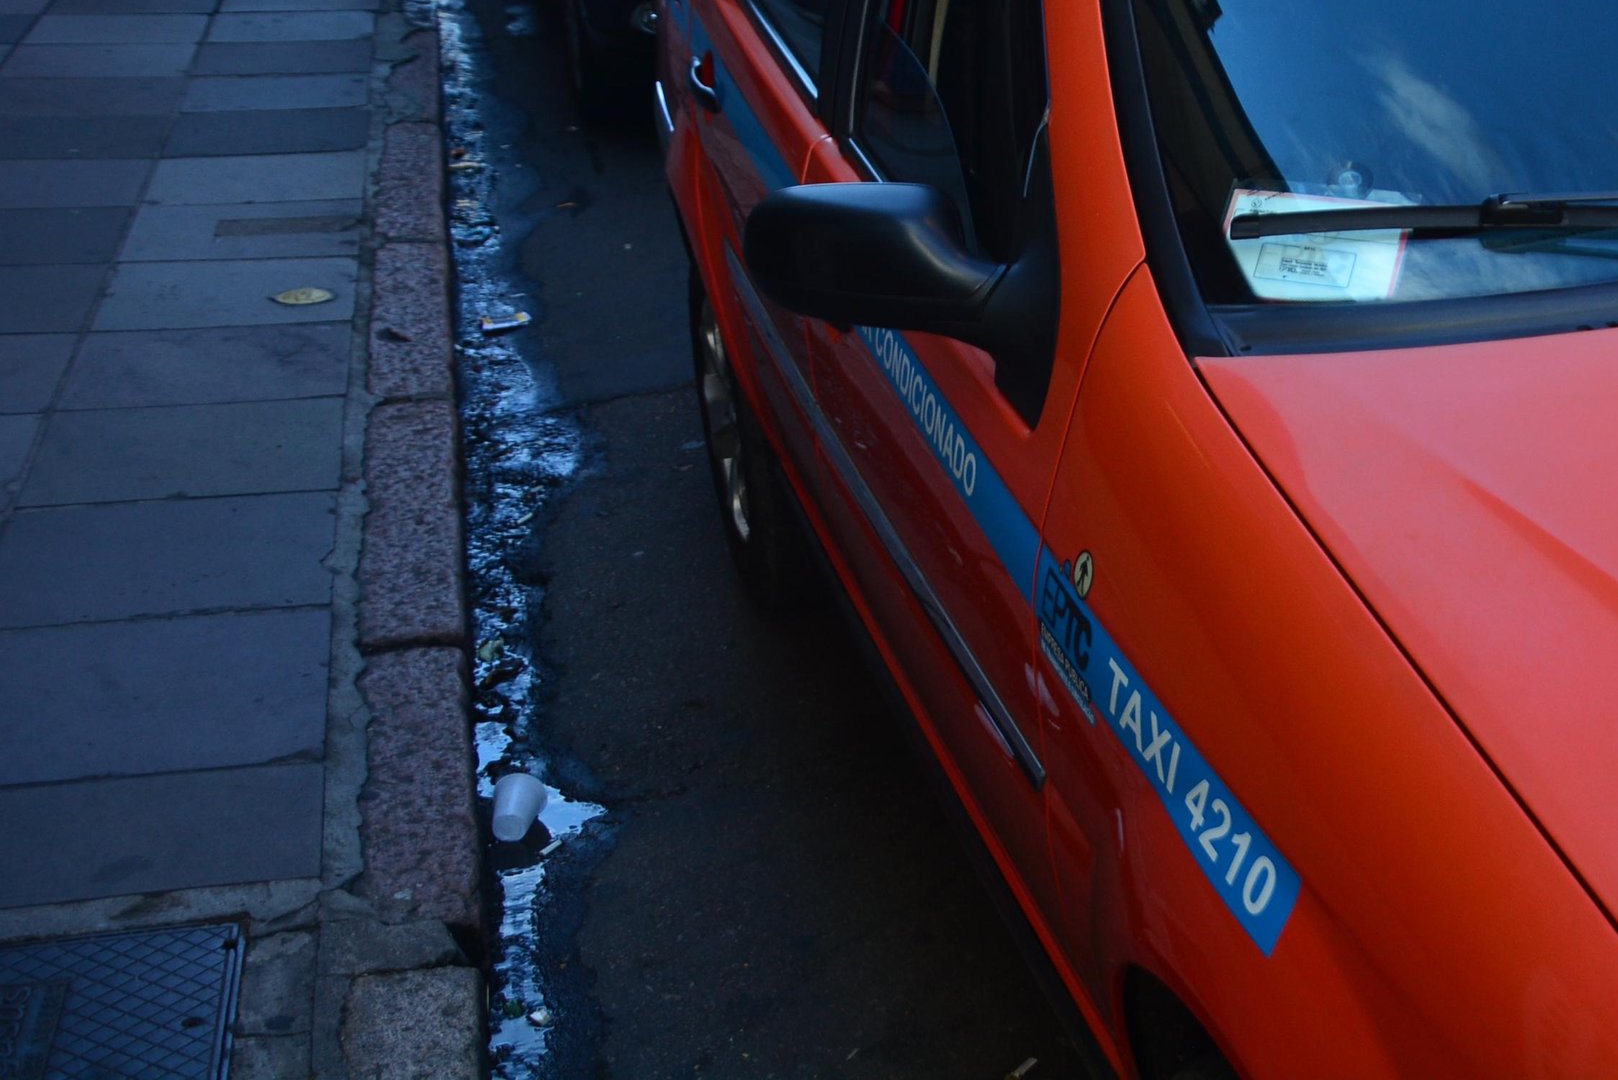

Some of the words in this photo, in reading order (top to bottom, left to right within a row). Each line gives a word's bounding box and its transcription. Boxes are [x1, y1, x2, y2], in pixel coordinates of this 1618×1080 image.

[875, 327, 976, 497] CONDICIONADO
[1042, 566, 1092, 671] EPTC
[1109, 657, 1181, 795] TAXI
[1185, 779, 1277, 916] 4210
